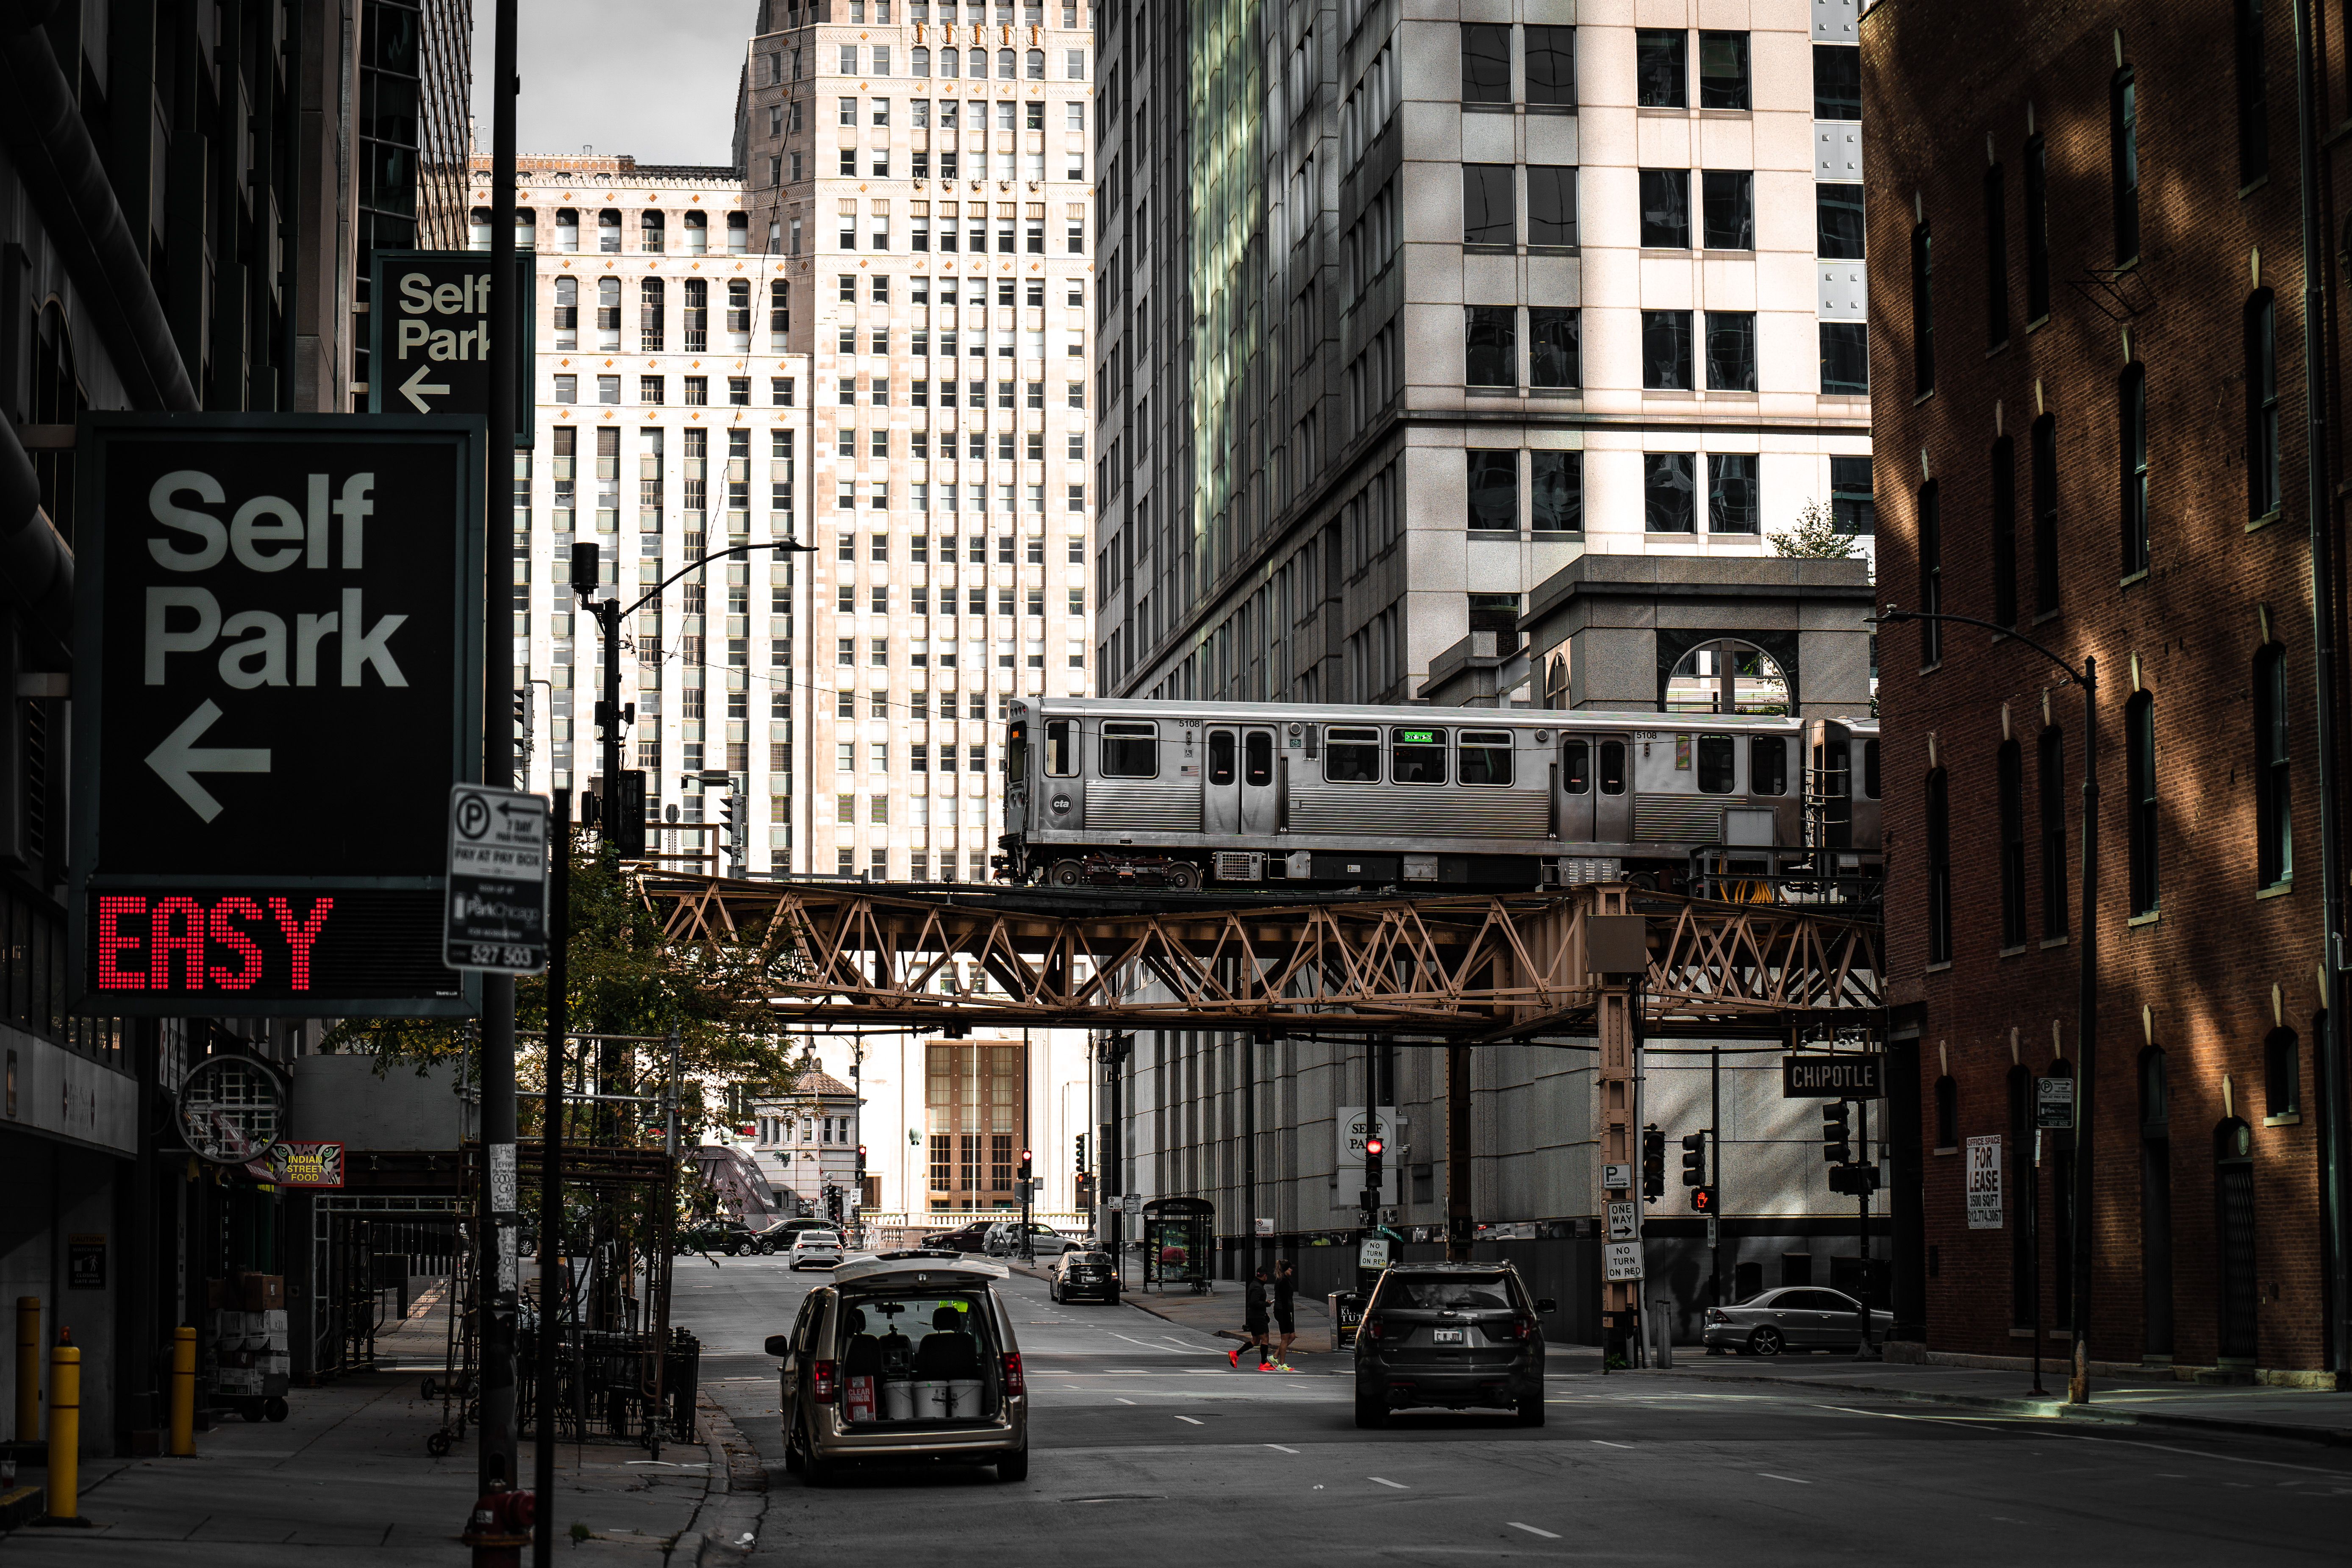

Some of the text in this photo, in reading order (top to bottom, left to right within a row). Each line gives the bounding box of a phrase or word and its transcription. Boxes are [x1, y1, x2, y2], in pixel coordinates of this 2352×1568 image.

[399, 273, 491, 314] Self
[147, 469, 375, 573] Self
[144, 587, 408, 691] Park
[455, 848, 539, 866] PAY AT PAY BOX
[99, 896, 334, 991] EASY
[470, 944, 532, 966] 527 503
[1793, 1066, 1874, 1088] CHIPOTLE
[1352, 1124, 1383, 1134] SEF
[1968, 1136, 2000, 1146] OFFICE SPACE
[289, 1155, 322, 1164] INDIAN
[1974, 1147, 1992, 1168] FOR
[287, 1165, 323, 1173] STREET
[291, 1174, 319, 1182] FOOD
[1969, 1170, 1998, 1192] LEASE
[1969, 1195, 1981, 1207] 3500
[1612, 1205, 1631, 1214] ONE
[1612, 1215, 1632, 1224] WAY
[1968, 1210, 2002, 1222] 312.774.3067
[1613, 1257, 1635, 1265] TURN
[1624, 1267, 1641, 1275] RED
[1341, 1314, 1363, 1322] TUT
